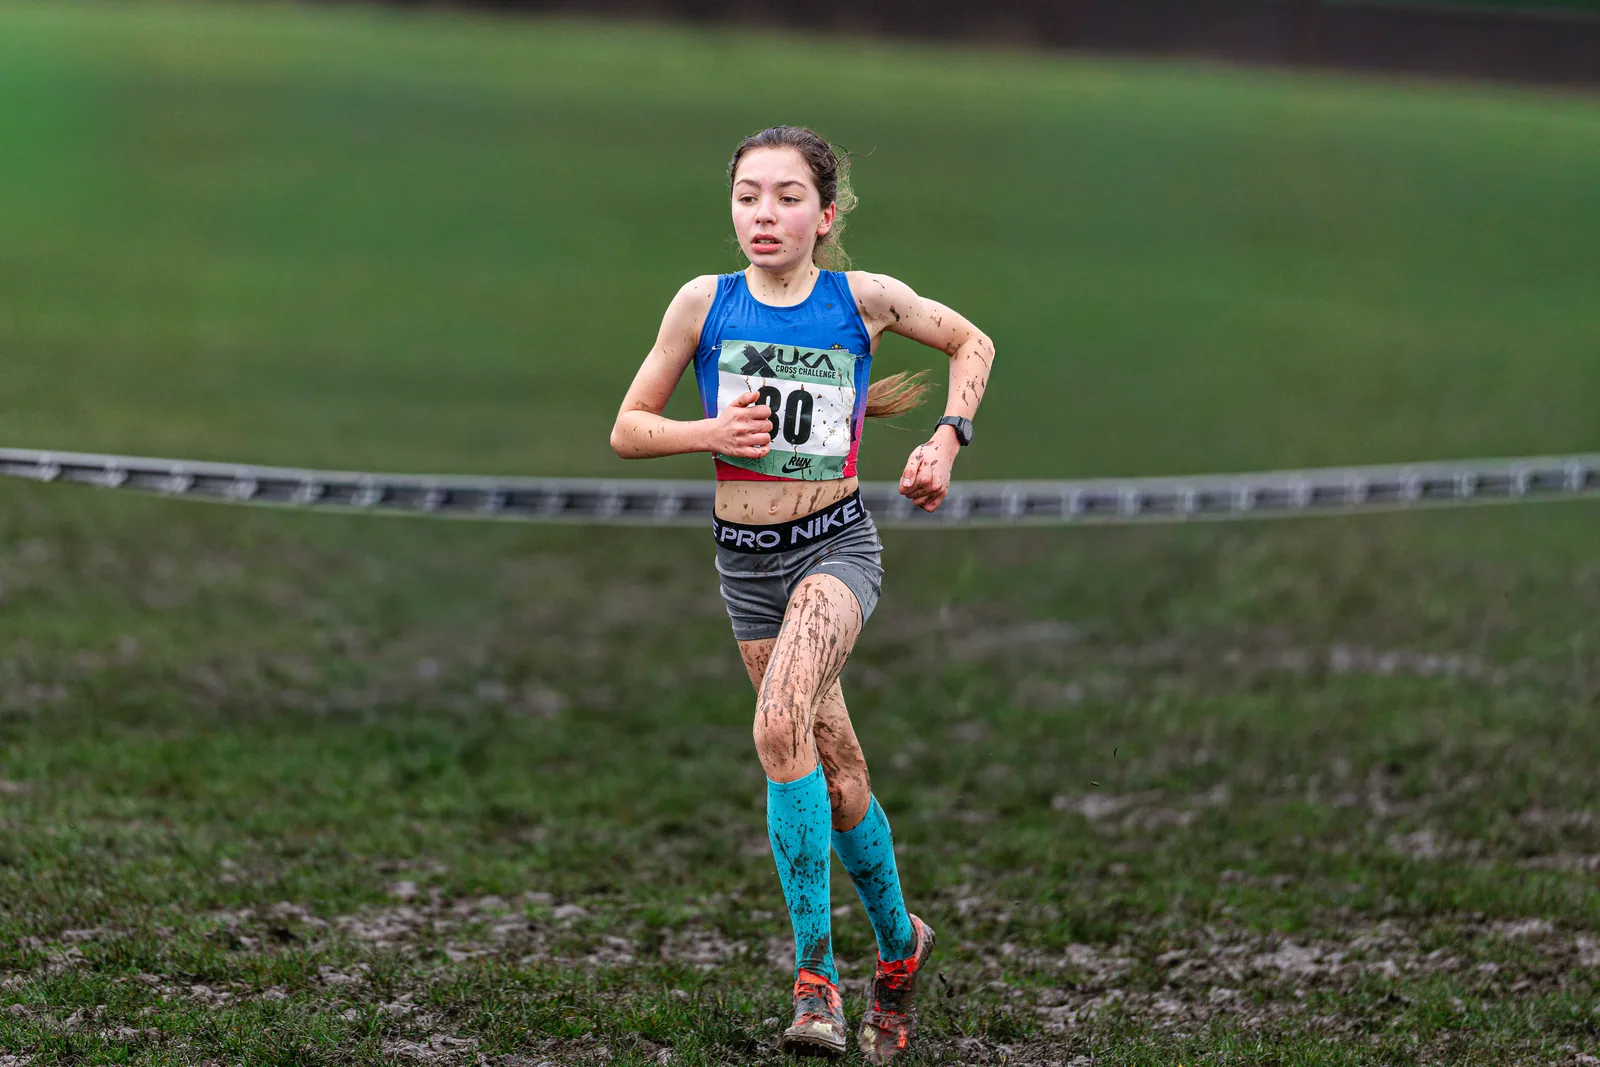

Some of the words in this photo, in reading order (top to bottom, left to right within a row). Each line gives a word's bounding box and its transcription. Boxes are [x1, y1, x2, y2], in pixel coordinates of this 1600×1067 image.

[777, 348, 835, 371] UKA
[775, 365, 797, 375] CROSS
[798, 368, 836, 379] CHALLENGE
[721, 527, 781, 548] PRO
[791, 499, 861, 544] NIKE
